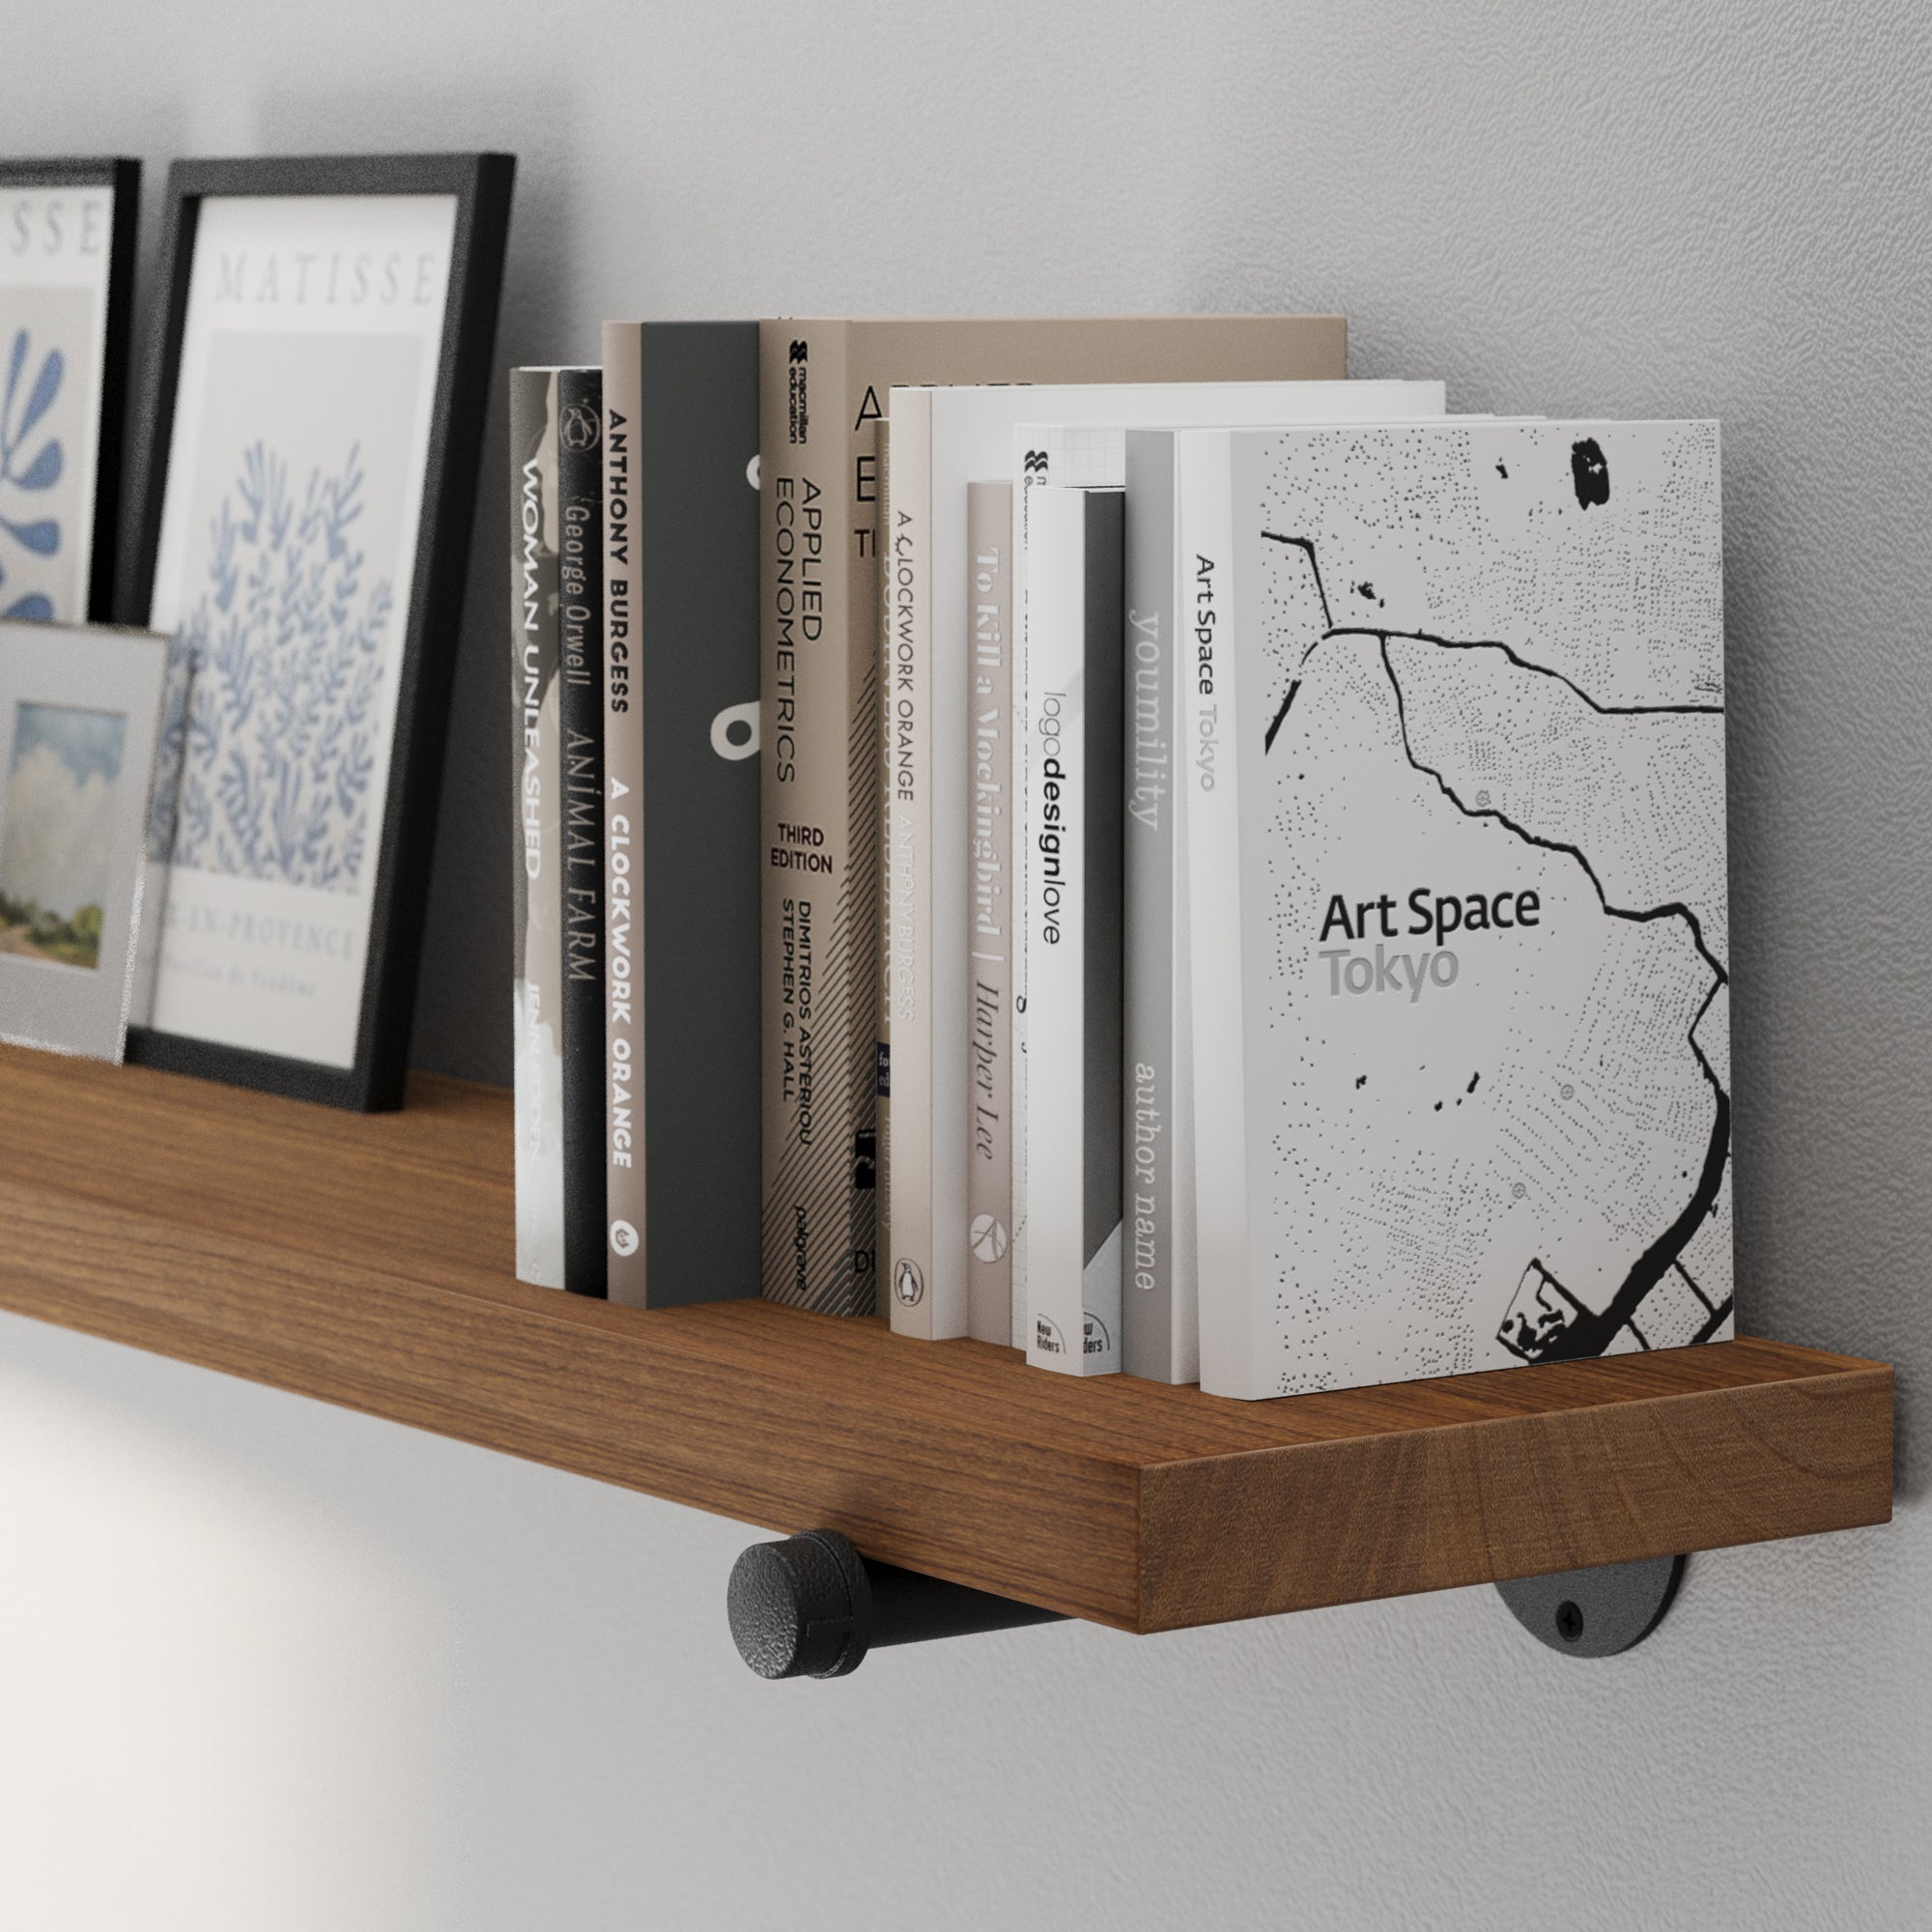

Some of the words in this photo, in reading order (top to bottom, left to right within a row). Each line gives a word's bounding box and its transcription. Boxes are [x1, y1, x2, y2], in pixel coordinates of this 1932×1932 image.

[212, 253, 436, 306] MATISSE
[789, 367, 798, 444] education
[799, 367, 809, 444] macmillan
[610, 409, 629, 564] ANTHONY
[896, 511, 913, 527] A
[523, 459, 539, 632] WOMAN
[561, 505, 591, 595] George
[802, 478, 822, 640] APPLIED
[976, 547, 1000, 593] To
[1196, 554, 1215, 604] Art
[566, 605, 591, 685] Orwell
[610, 580, 629, 713] BURGESS
[776, 478, 795, 782] ECONOMETRICS
[894, 533, 914, 692] CLOCKWORK
[976, 605, 1001, 667] Kill
[1195, 610, 1216, 696] Space
[976, 675, 993, 695] a
[1128, 610, 1168, 831] youmility
[523, 645, 542, 880] UNLEASHED
[611, 777, 630, 799] A
[896, 699, 915, 802] ORANGE
[1196, 704, 1219, 792] Tokyo
[771, 848, 833, 874] EDITION
[778, 823, 824, 847] THIRD
[972, 708, 1002, 936] Mockingbird
[568, 886, 596, 981] FARM
[611, 814, 631, 1025] CLOCKWORK
[782, 899, 795, 1005] STEPHEN
[798, 900, 811, 1022] DIMITRIOS
[1319, 895, 1399, 942] Art
[1408, 887, 1540, 947] Space
[1318, 944, 1460, 1004] Tokyo
[782, 1012, 795, 1037] G.
[972, 980, 999, 1100] Harper
[612, 1038, 632, 1169] ORANGE
[783, 1042, 795, 1102] HALL
[798, 1029, 812, 1147] ASTERIOU
[976, 1103, 999, 1161] Lee
[1135, 1063, 1160, 1186] author
[794, 1205, 810, 1291] palgrave
[1134, 1193, 1156, 1292] name
